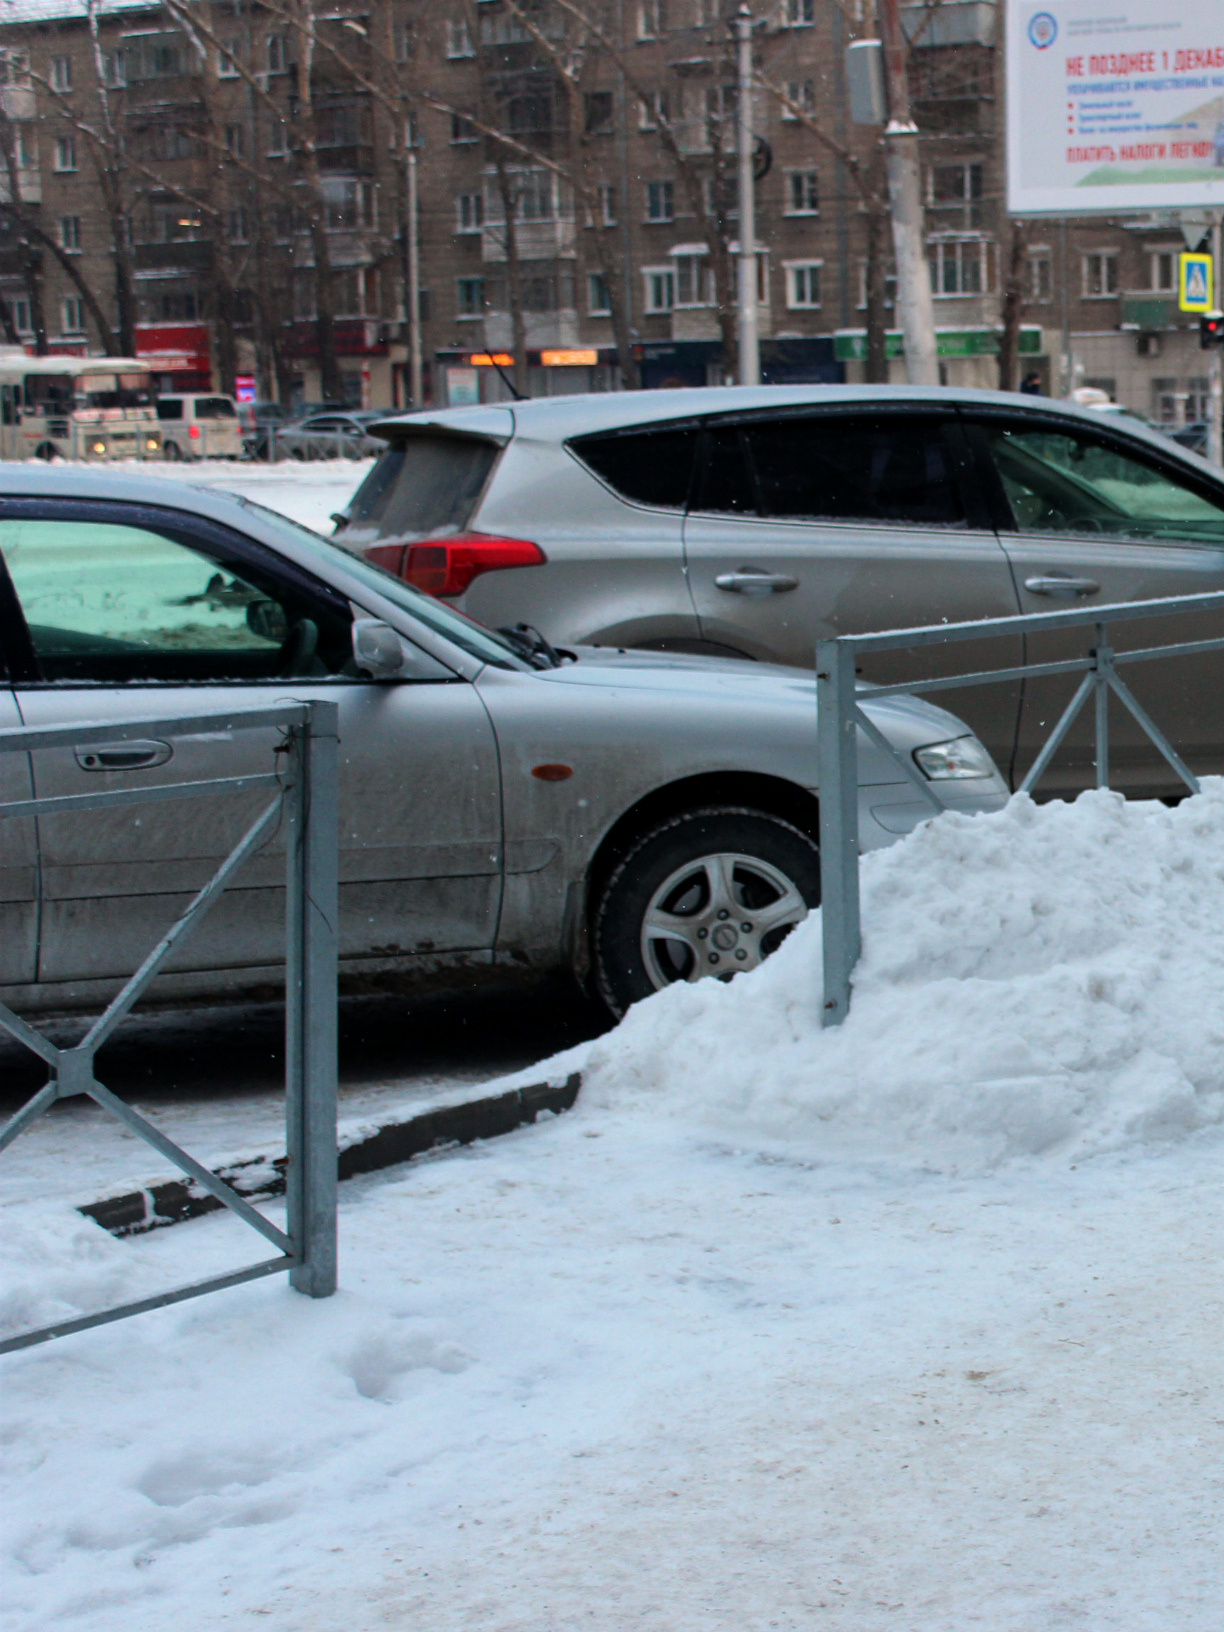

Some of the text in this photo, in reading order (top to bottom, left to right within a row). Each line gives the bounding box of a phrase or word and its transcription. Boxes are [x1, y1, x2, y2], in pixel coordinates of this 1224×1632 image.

[1065, 56, 1084, 76] НЕ
[1089, 51, 1155, 76] ПОЗДНЕЕ
[1162, 51, 1169, 70] 1
[1067, 146, 1117, 163] ПЛАТИТЬ
[1118, 143, 1166, 160] НАЛОГИ
